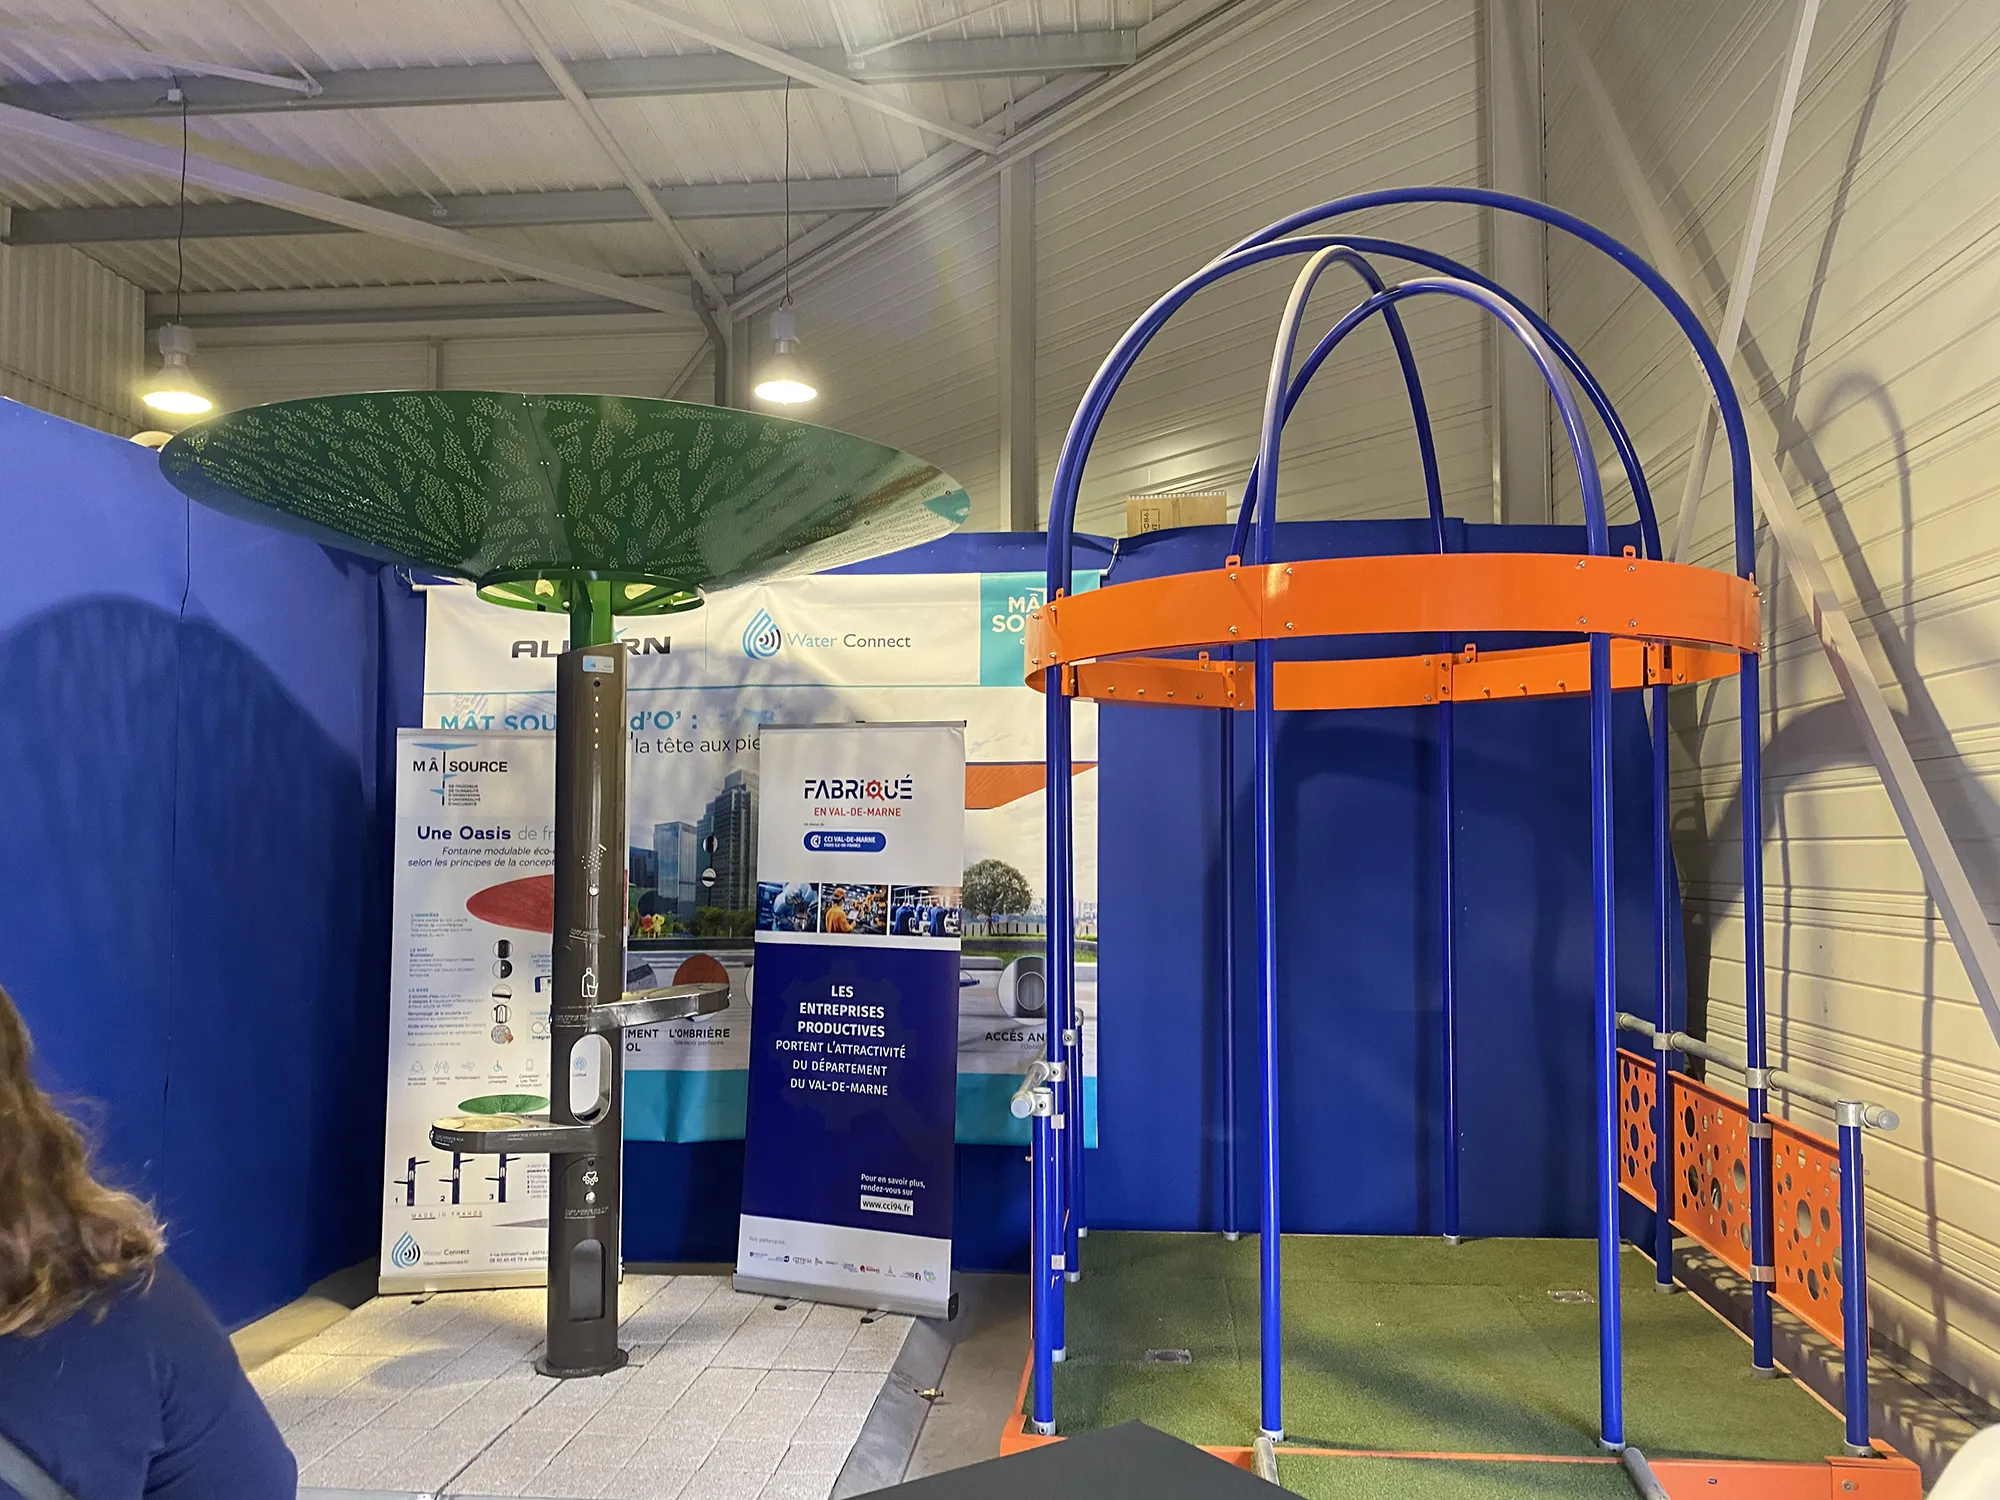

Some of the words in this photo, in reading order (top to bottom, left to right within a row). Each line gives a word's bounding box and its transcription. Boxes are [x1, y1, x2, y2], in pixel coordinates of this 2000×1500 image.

[992, 614, 1026, 633] SO
[787, 632, 837, 648] Water
[843, 633, 911, 649] Connect
[441, 710, 495, 730] MÂT
[504, 715, 556, 731] SOU
[657, 737, 694, 753] tête
[700, 740, 731, 752] aux
[735, 735, 760, 753] pie
[449, 761, 508, 772] SOURCE
[814, 807, 826, 816] EN
[829, 807, 901, 817] VAL-DE-MARNE
[417, 826, 452, 840] Une
[459, 826, 511, 840] Oasis
[518, 826, 537, 840] de
[543, 825, 555, 840] fr
[442, 847, 482, 855] Fontaine
[484, 847, 531, 855] modulable
[533, 847, 555, 855] éco-
[408, 858, 431, 866] selon
[434, 858, 447, 866] les
[450, 858, 491, 868] principes
[495, 858, 505, 866] de
[508, 858, 516, 866] la
[519, 859, 555, 868] concept
[831, 985, 854, 998] LES
[800, 1002, 885, 1019] ENTREPRISES
[625, 1029, 659, 1038] MENT
[669, 1027, 730, 1038] L'OMBRIÈRE
[798, 1021, 885, 1038] PRODUCTIVES
[985, 1030, 1023, 1041] ACCÈS
[1028, 1033, 1044, 1042] AN
[776, 1040, 824, 1052] PORTENT
[827, 1041, 906, 1058] L'ATTRACTIVITÉ
[793, 1060, 808, 1070] DU
[812, 1058, 887, 1076] DÉPARTEMENT
[790, 1078, 805, 1089] DU
[808, 1079, 888, 1096] VAL-DE-MARNE
[861, 1173, 877, 1183] Pour
[878, 1176, 886, 1184] en
[888, 1177, 908, 1186] savoir
[909, 1178, 926, 1189] plus,
[861, 1184, 901, 1195] rendez-vous
[902, 1188, 913, 1196] sur
[862, 1200, 911, 1213] www.cci94.fr
